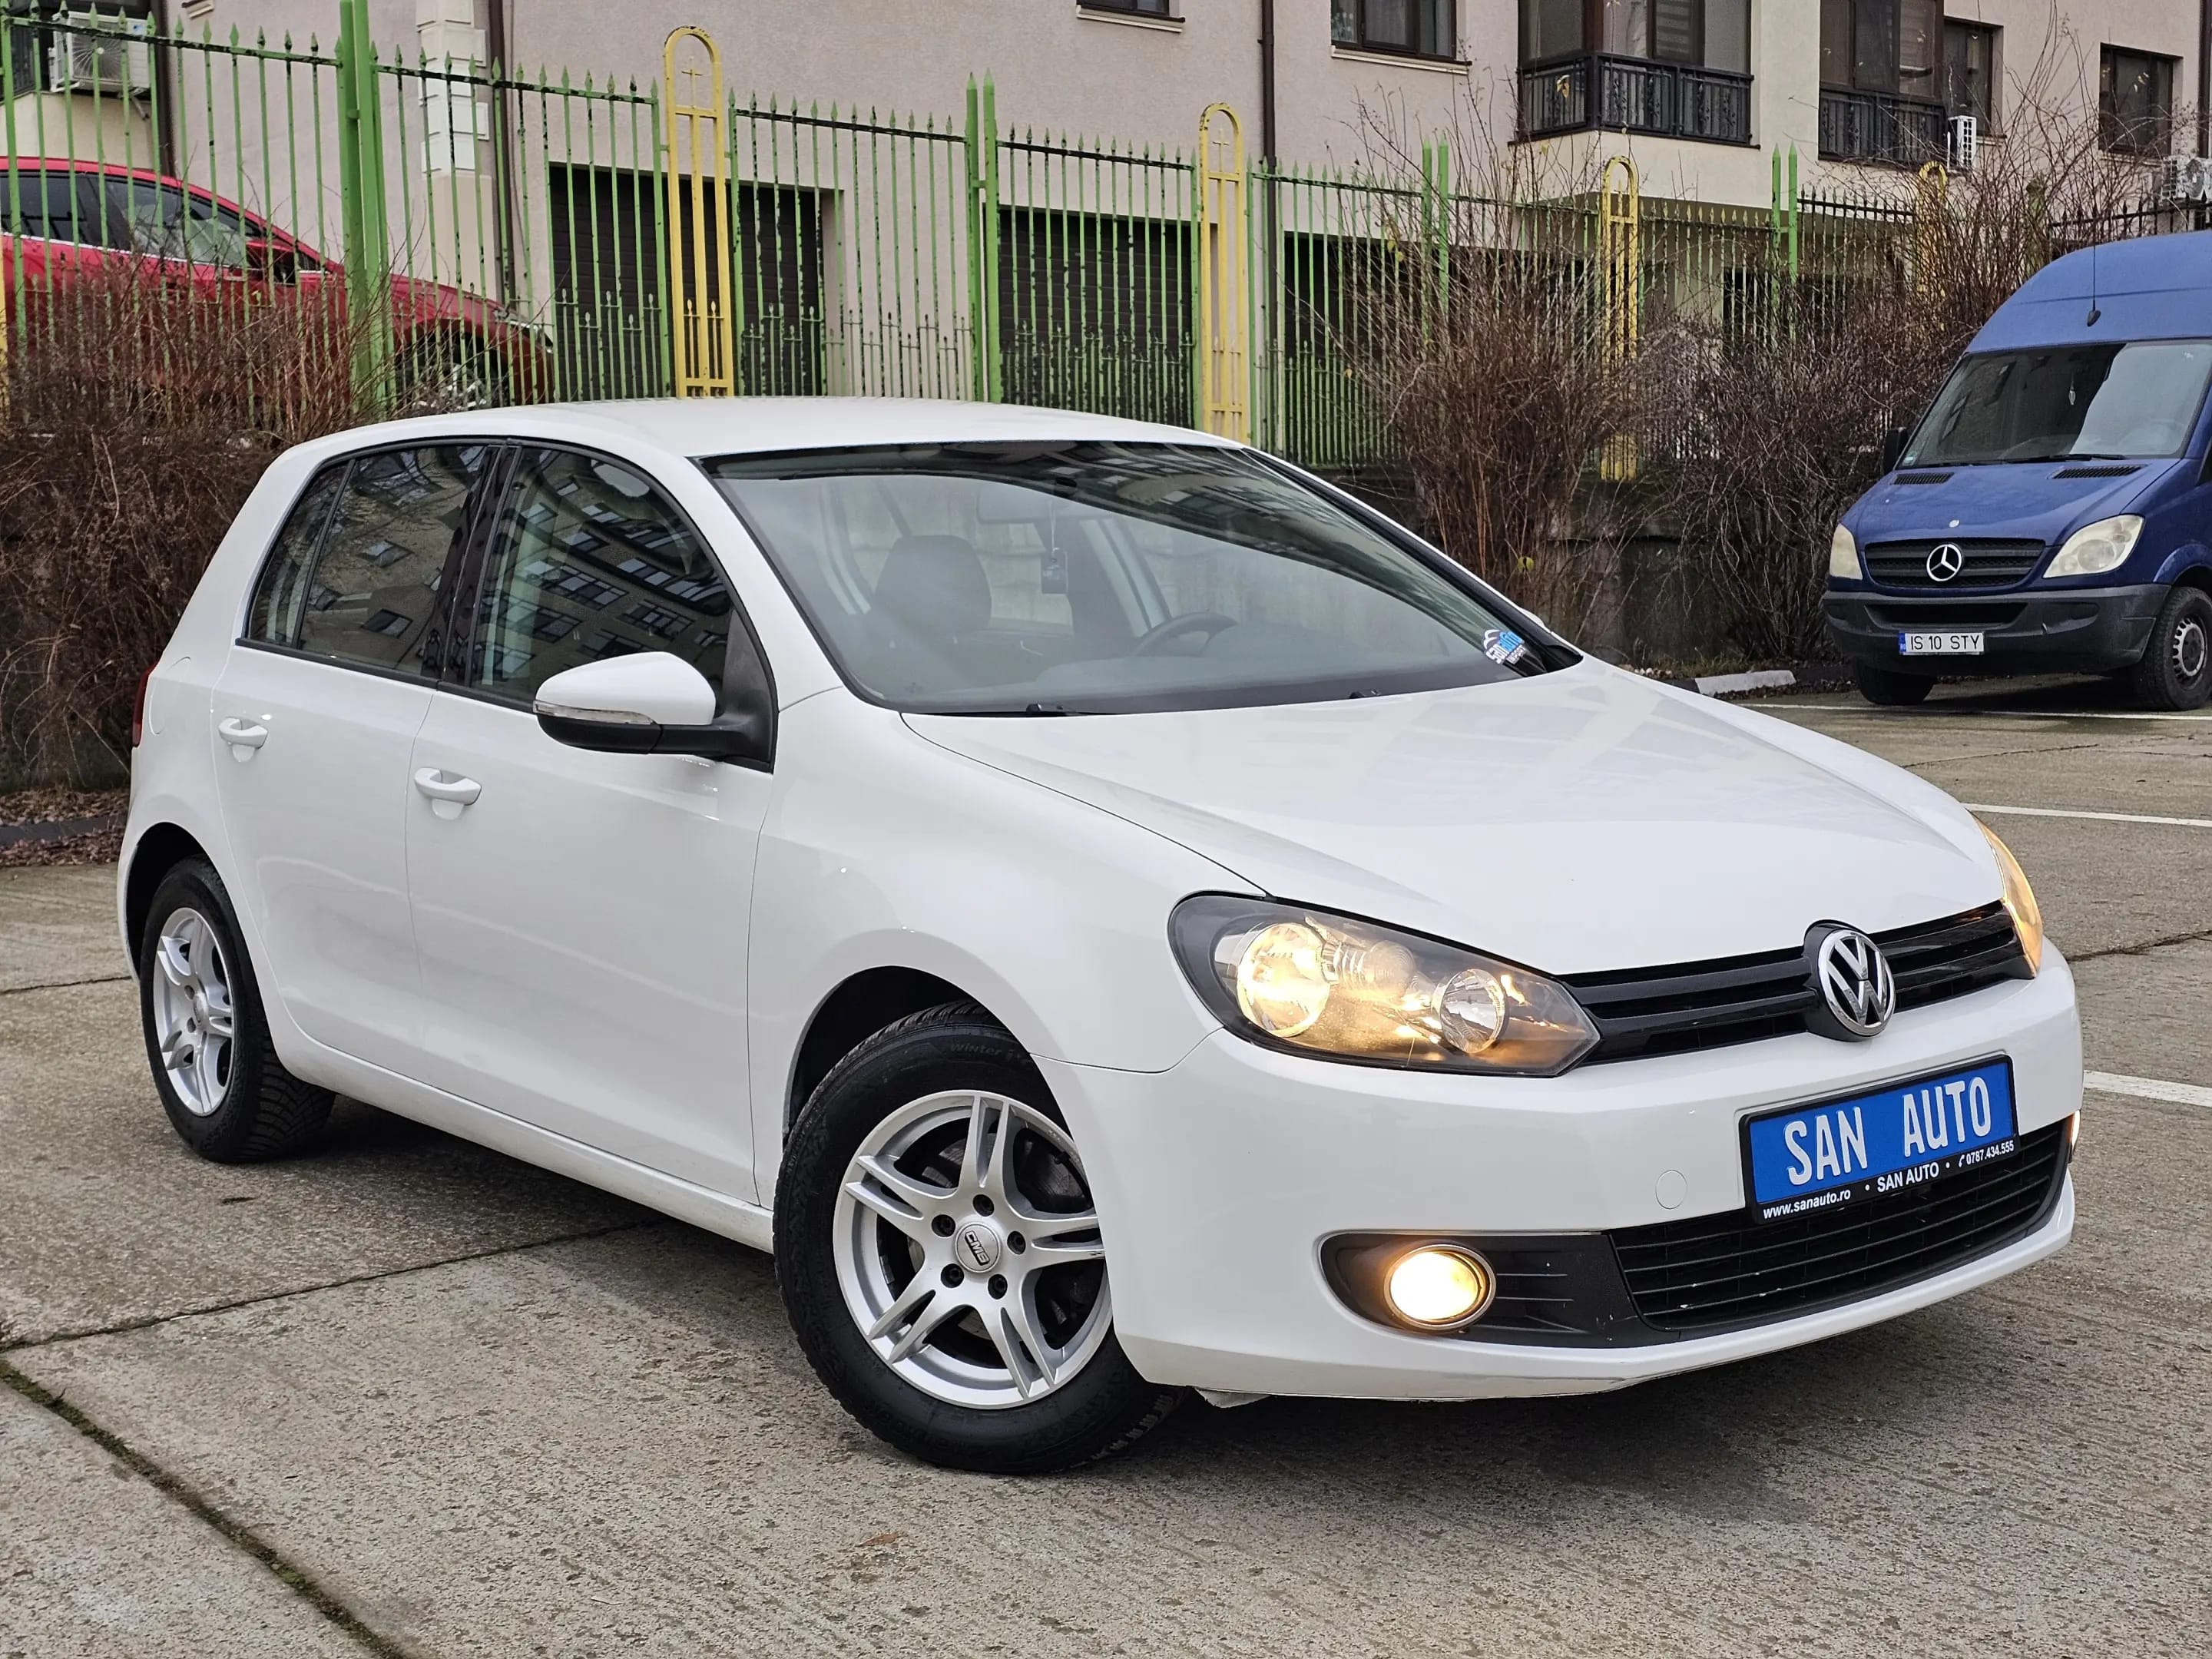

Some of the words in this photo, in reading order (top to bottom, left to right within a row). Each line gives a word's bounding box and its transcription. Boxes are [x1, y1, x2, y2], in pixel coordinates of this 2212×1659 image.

[1911, 635, 1923, 650] IS
[1929, 635, 1942, 650] 10
[1950, 635, 1980, 650] STY
[1783, 1106, 1868, 1185] SAN
[1902, 1077, 1992, 1157] AUTO
[1763, 1189, 1851, 1220] www.sanauto.ro
[1877, 1171, 1903, 1193] SAN
[1906, 1161, 1940, 1185] AUTO
[1966, 1140, 2015, 1165] 0787.434.555
